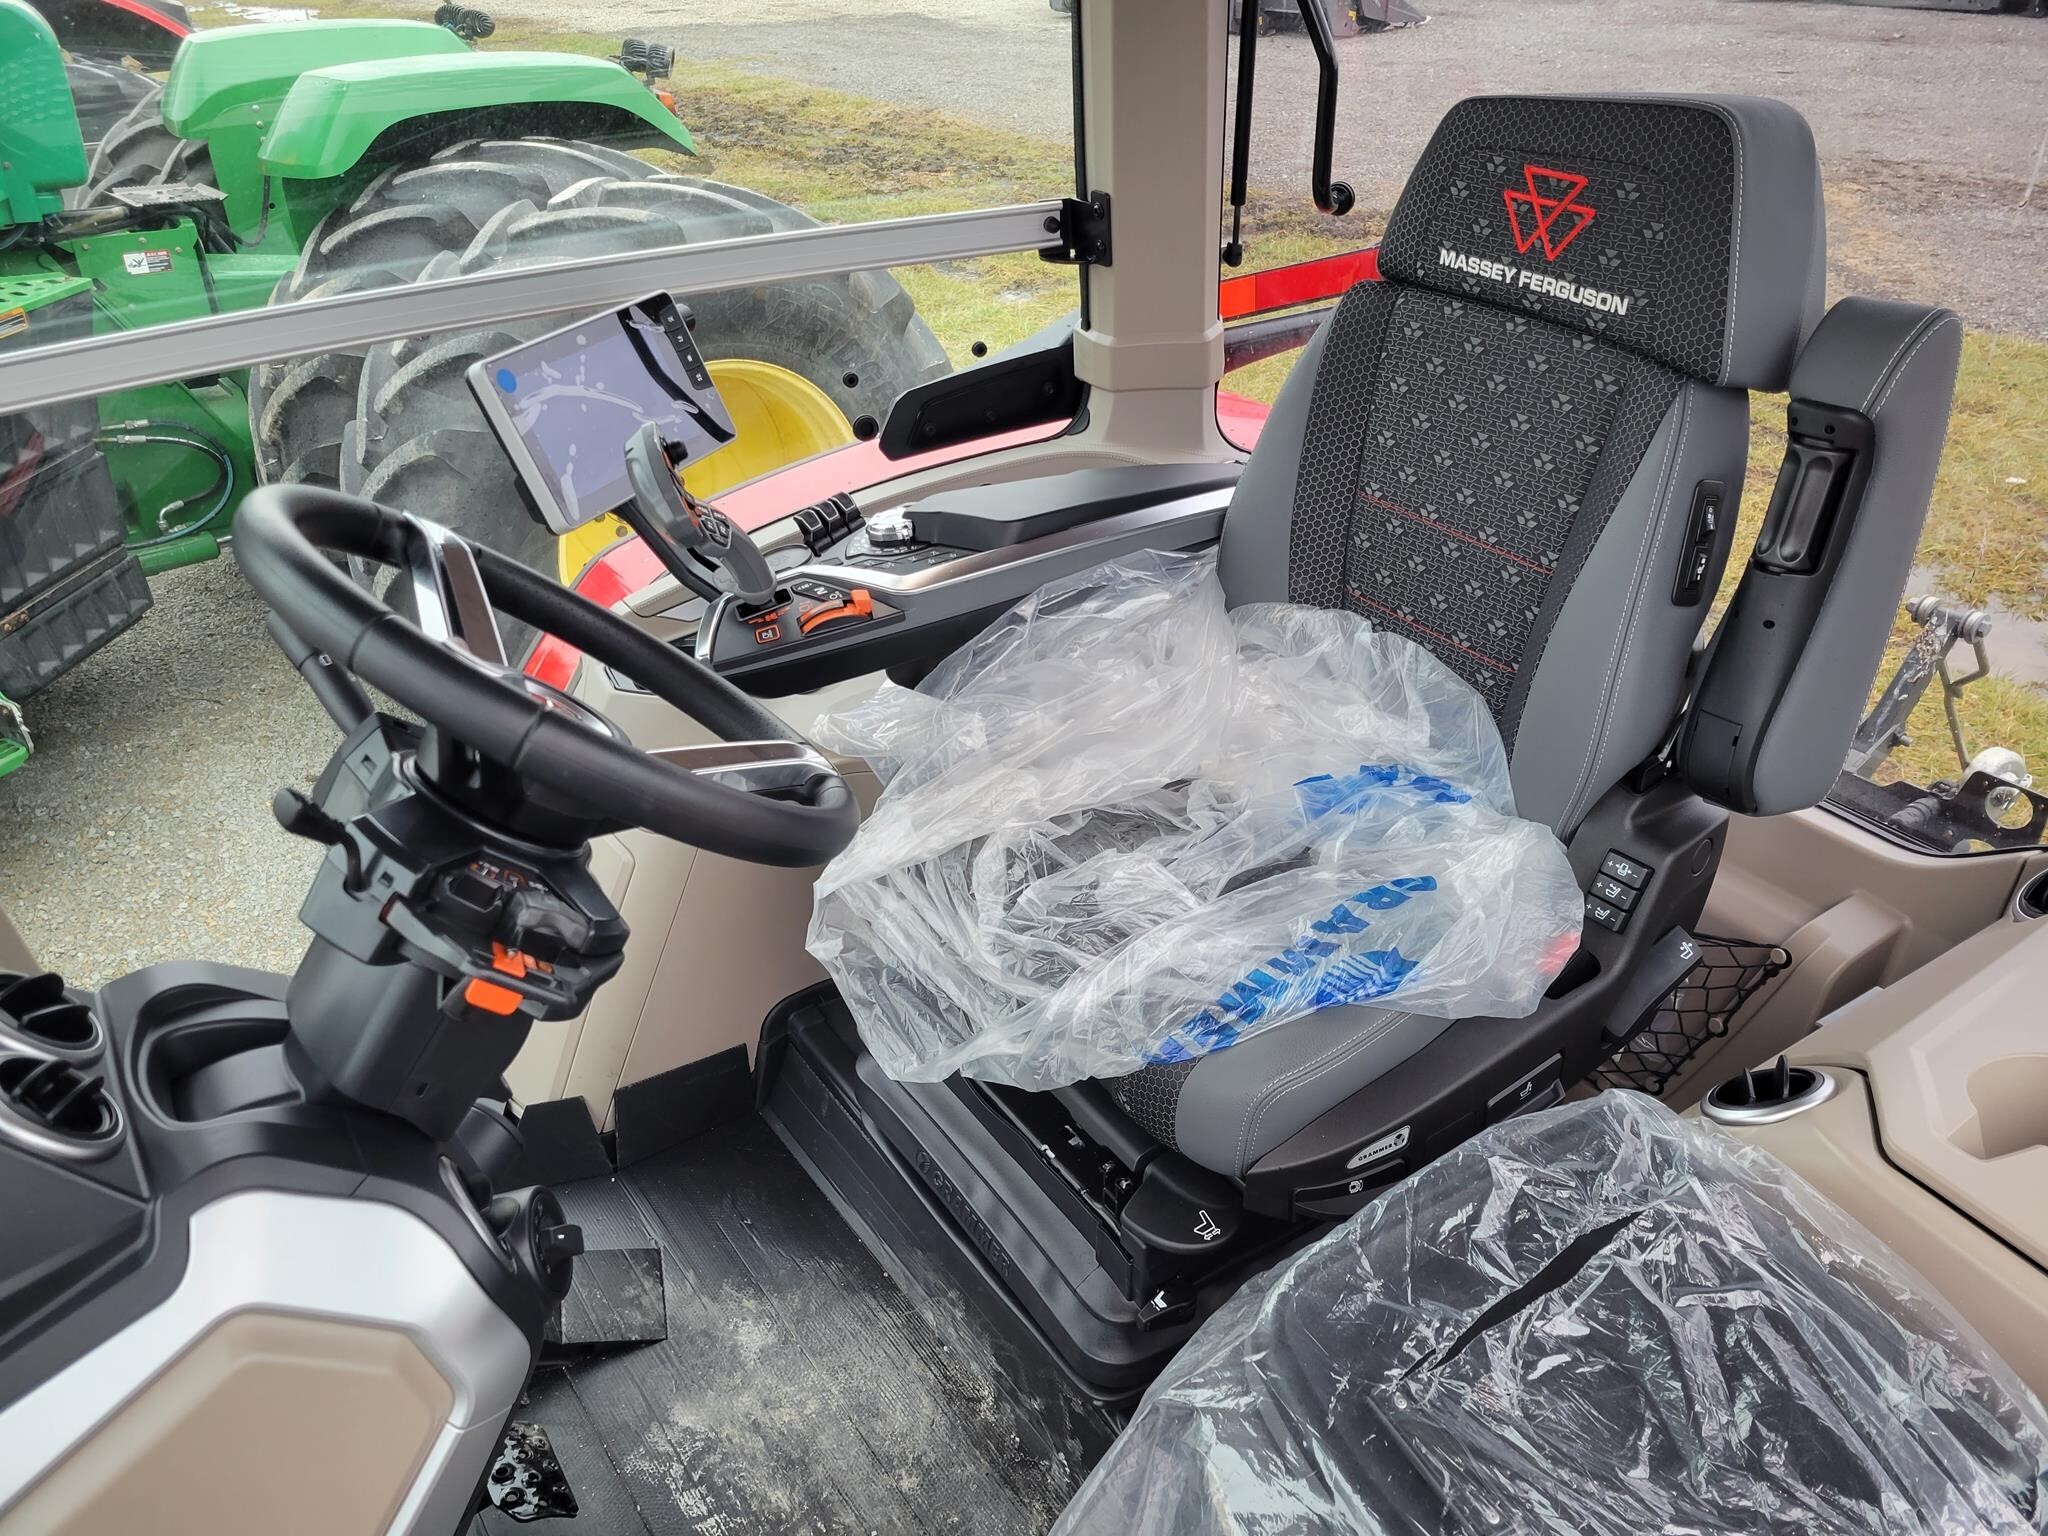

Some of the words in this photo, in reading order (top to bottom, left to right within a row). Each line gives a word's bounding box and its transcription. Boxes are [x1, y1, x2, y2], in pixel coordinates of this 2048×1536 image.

[1439, 249, 1517, 284] MASSEY
[1518, 271, 1629, 315] FERGUSON
[1358, 1143, 1393, 1161] GRAMMER
